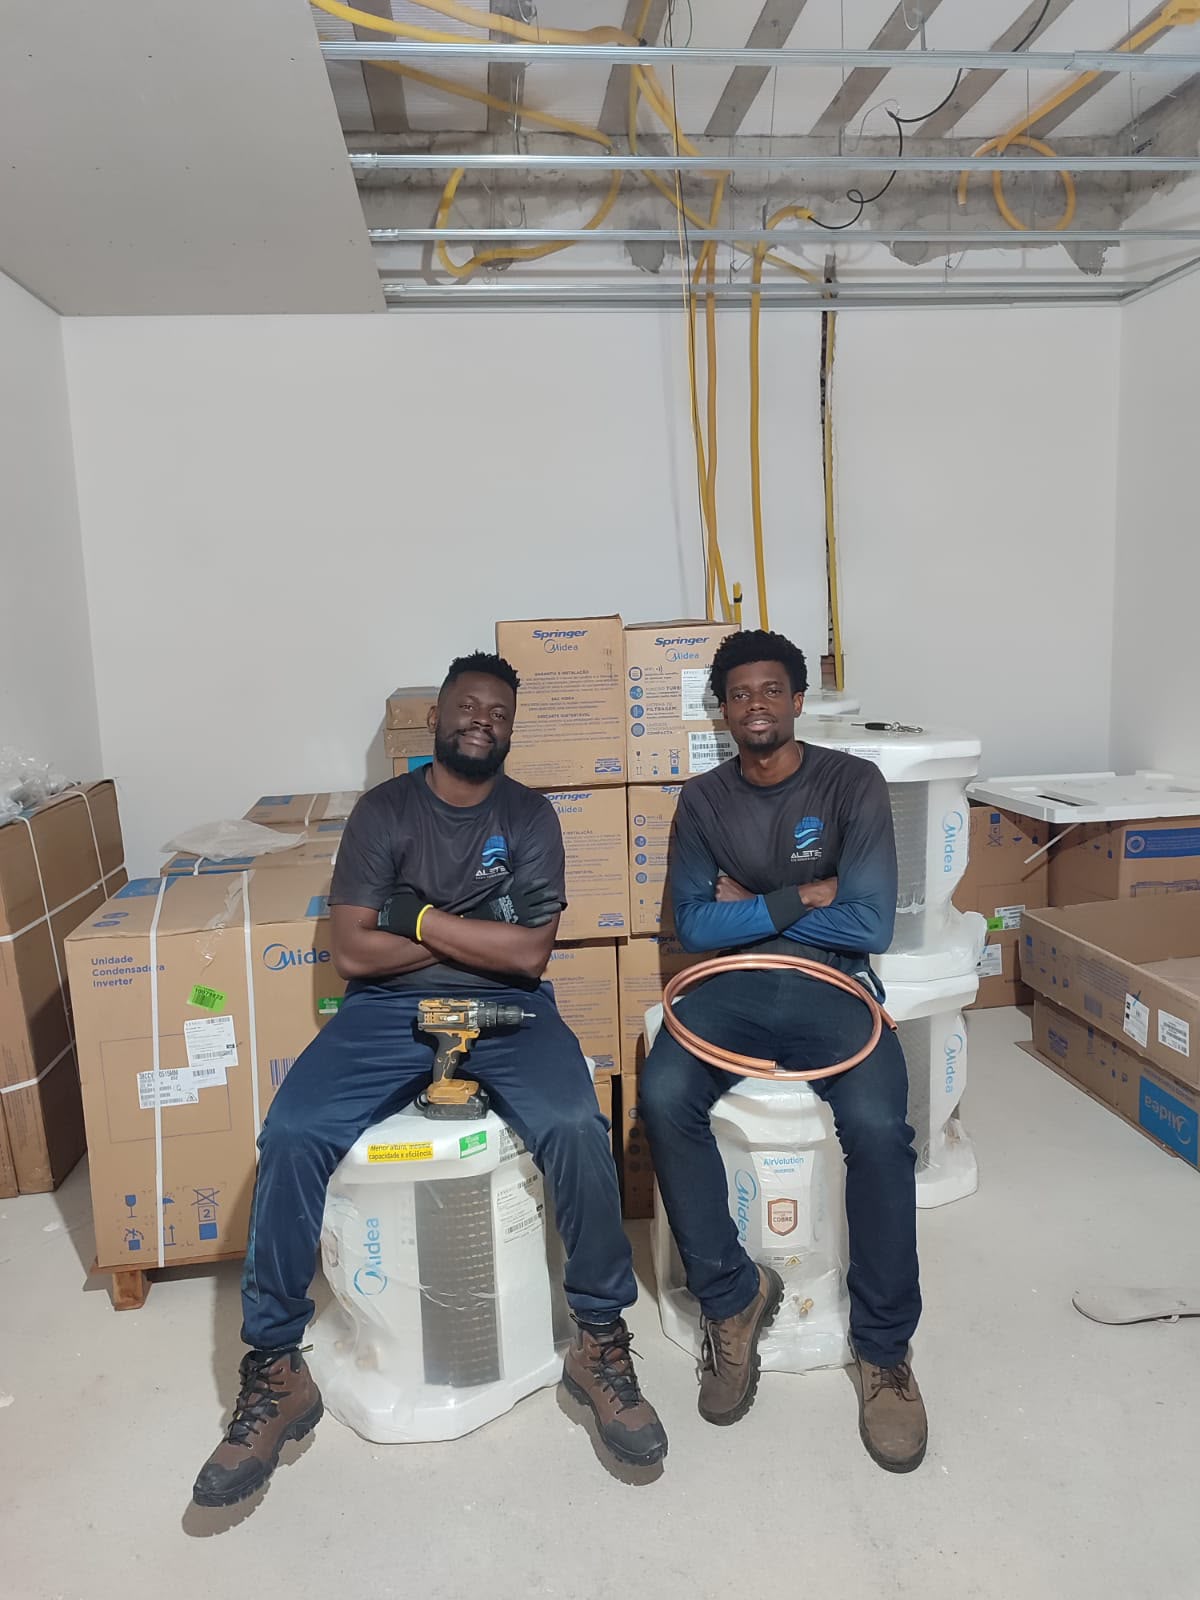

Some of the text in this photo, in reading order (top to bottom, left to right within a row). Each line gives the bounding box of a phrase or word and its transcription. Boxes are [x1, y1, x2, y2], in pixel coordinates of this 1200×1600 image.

[531, 629, 588, 640] Springer
[543, 638, 578, 654] Midea
[654, 636, 710, 647] Springer
[664, 647, 700, 662] Midea
[546, 792, 592, 801] pringer
[942, 810, 963, 873] Midea
[91, 956, 133, 965] Unidade
[92, 965, 165, 977] Condensada
[93, 978, 133, 988] Inverter
[944, 1034, 963, 1094] Midea
[1144, 1094, 1192, 1145] Midea
[763, 1156, 804, 1167] AirVolution
[734, 1168, 757, 1242] Midea
[203, 1208, 211, 1218] 2
[353, 1217, 388, 1296] Midea
